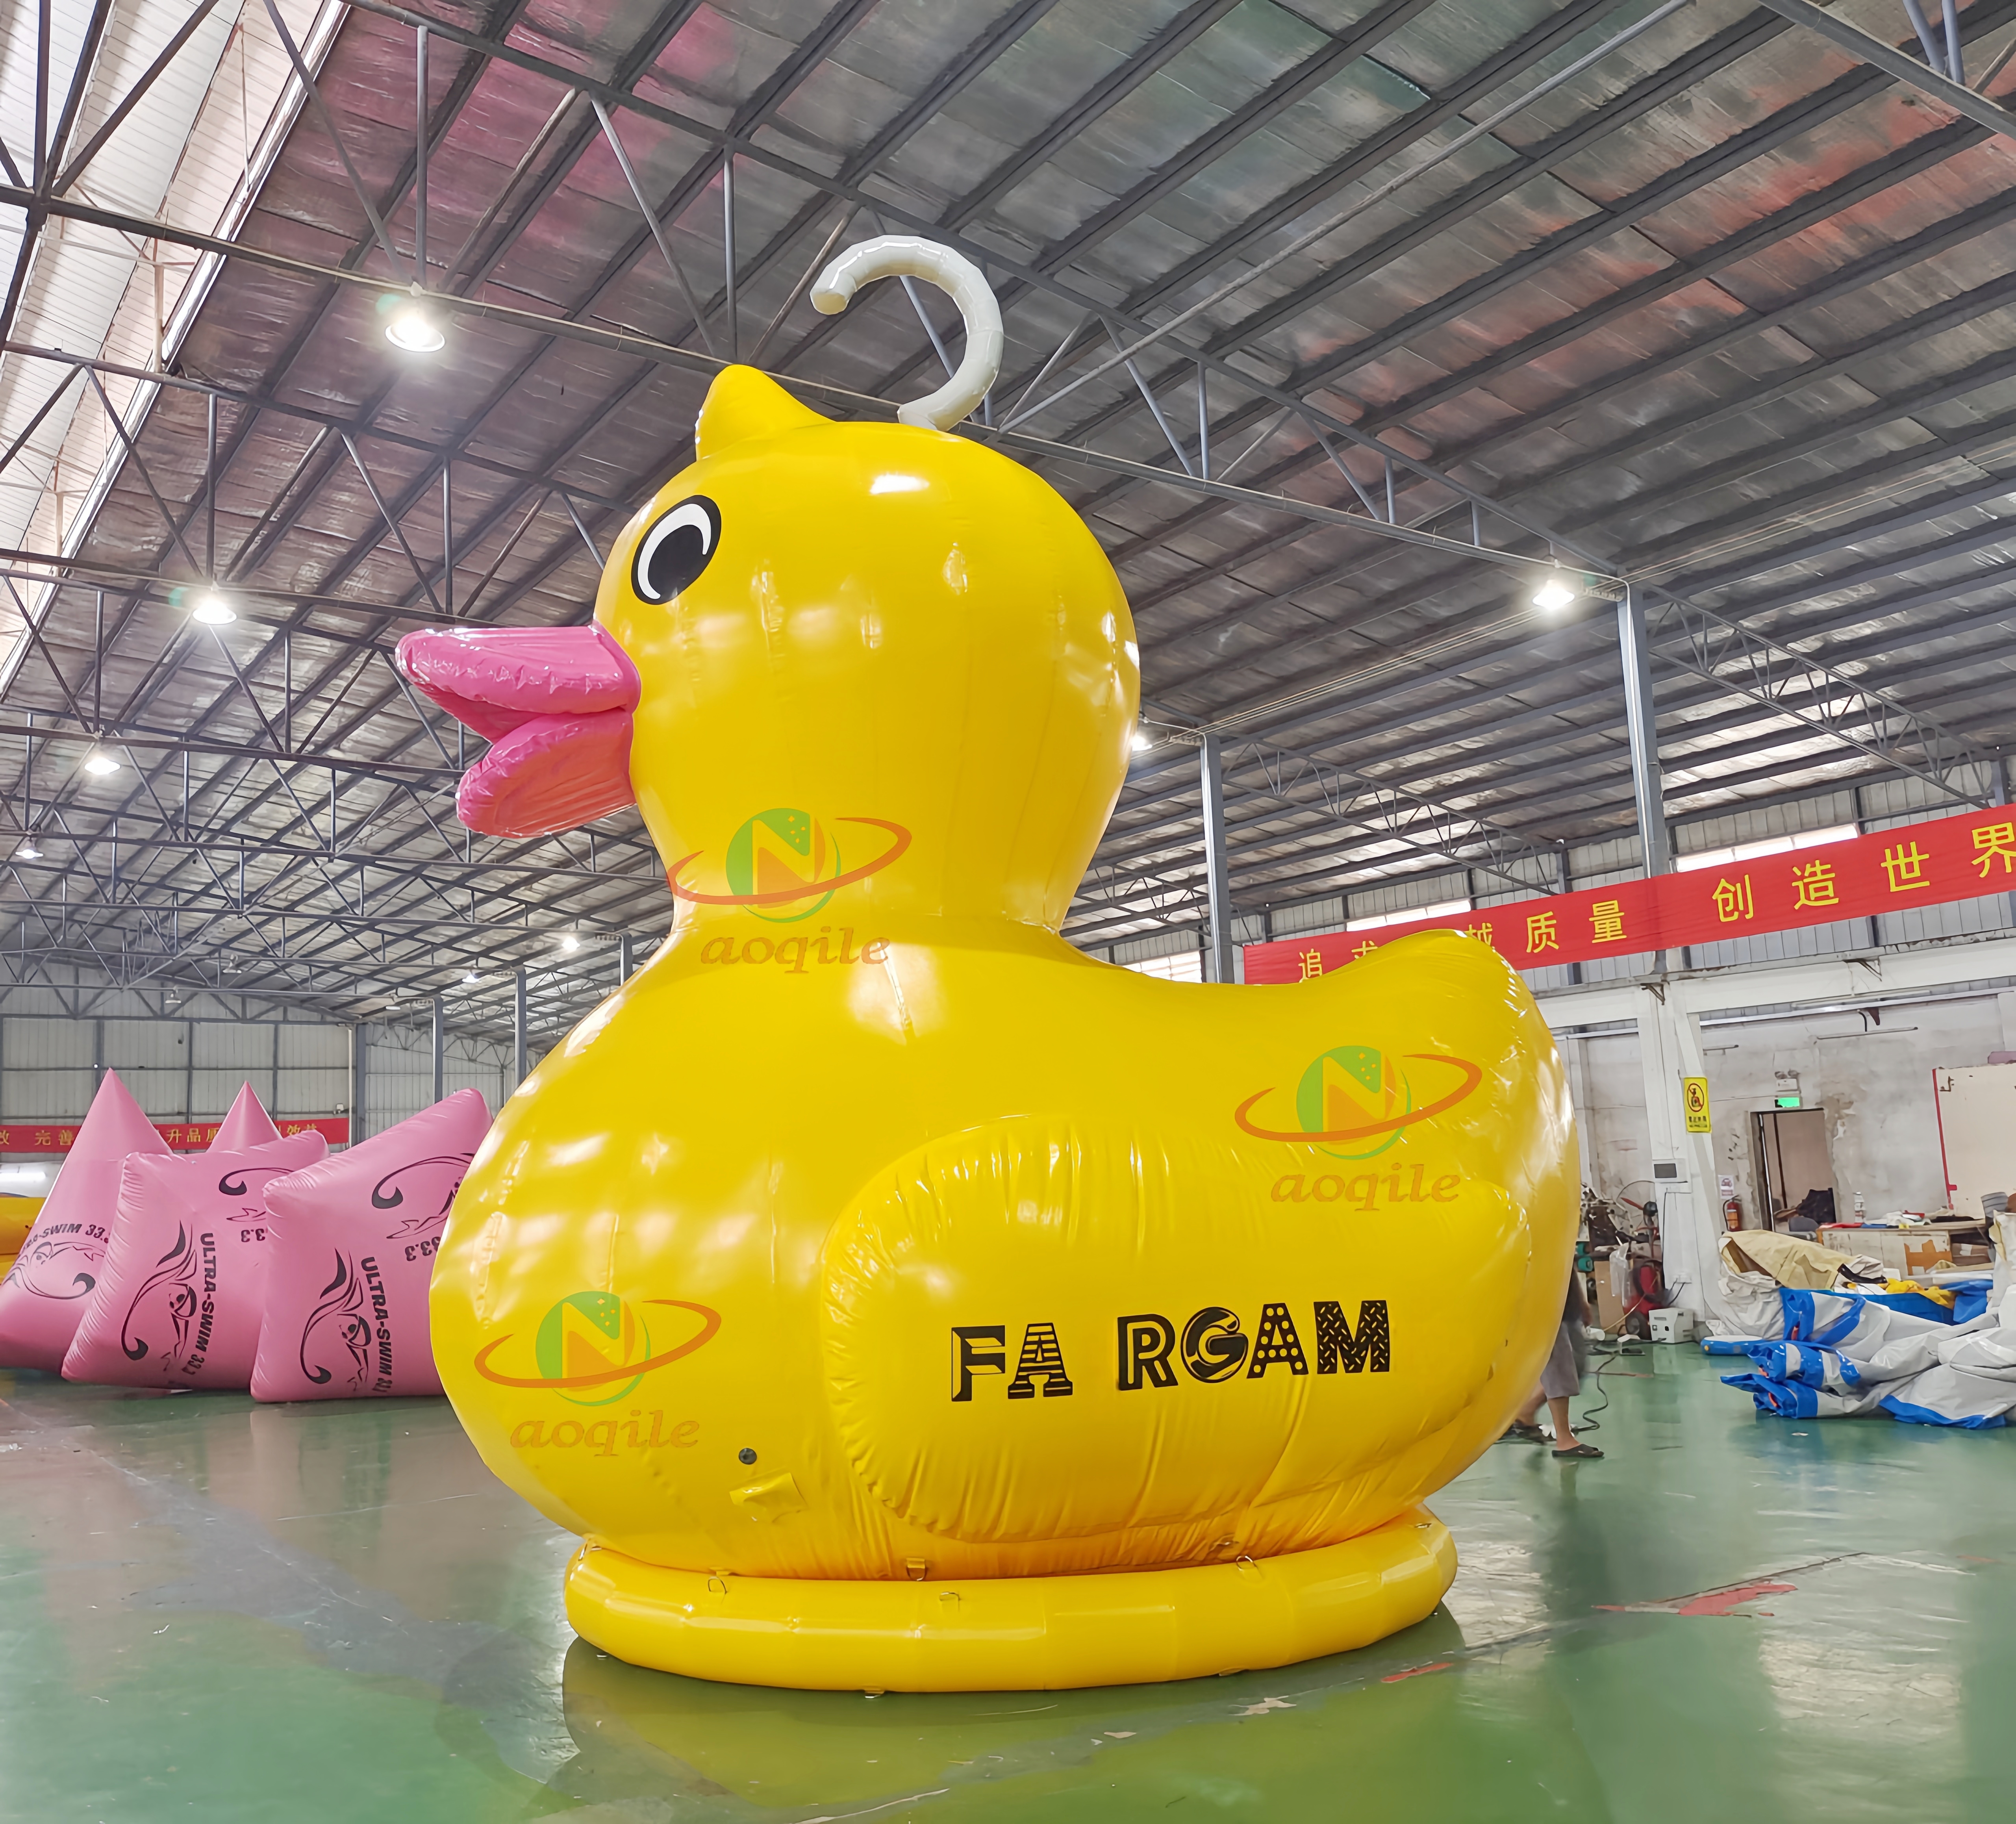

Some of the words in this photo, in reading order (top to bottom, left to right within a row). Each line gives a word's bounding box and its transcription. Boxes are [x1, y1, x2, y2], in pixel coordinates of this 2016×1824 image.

[1712, 822, 2016, 922] 创造世界
[196, 1233, 216, 1352] ULTRA-SWIM
[361, 1257, 392, 1376] ULTRA-SWIM
[951, 1322, 1073, 1402] FA
[1116, 1300, 1391, 1391] RGAM
